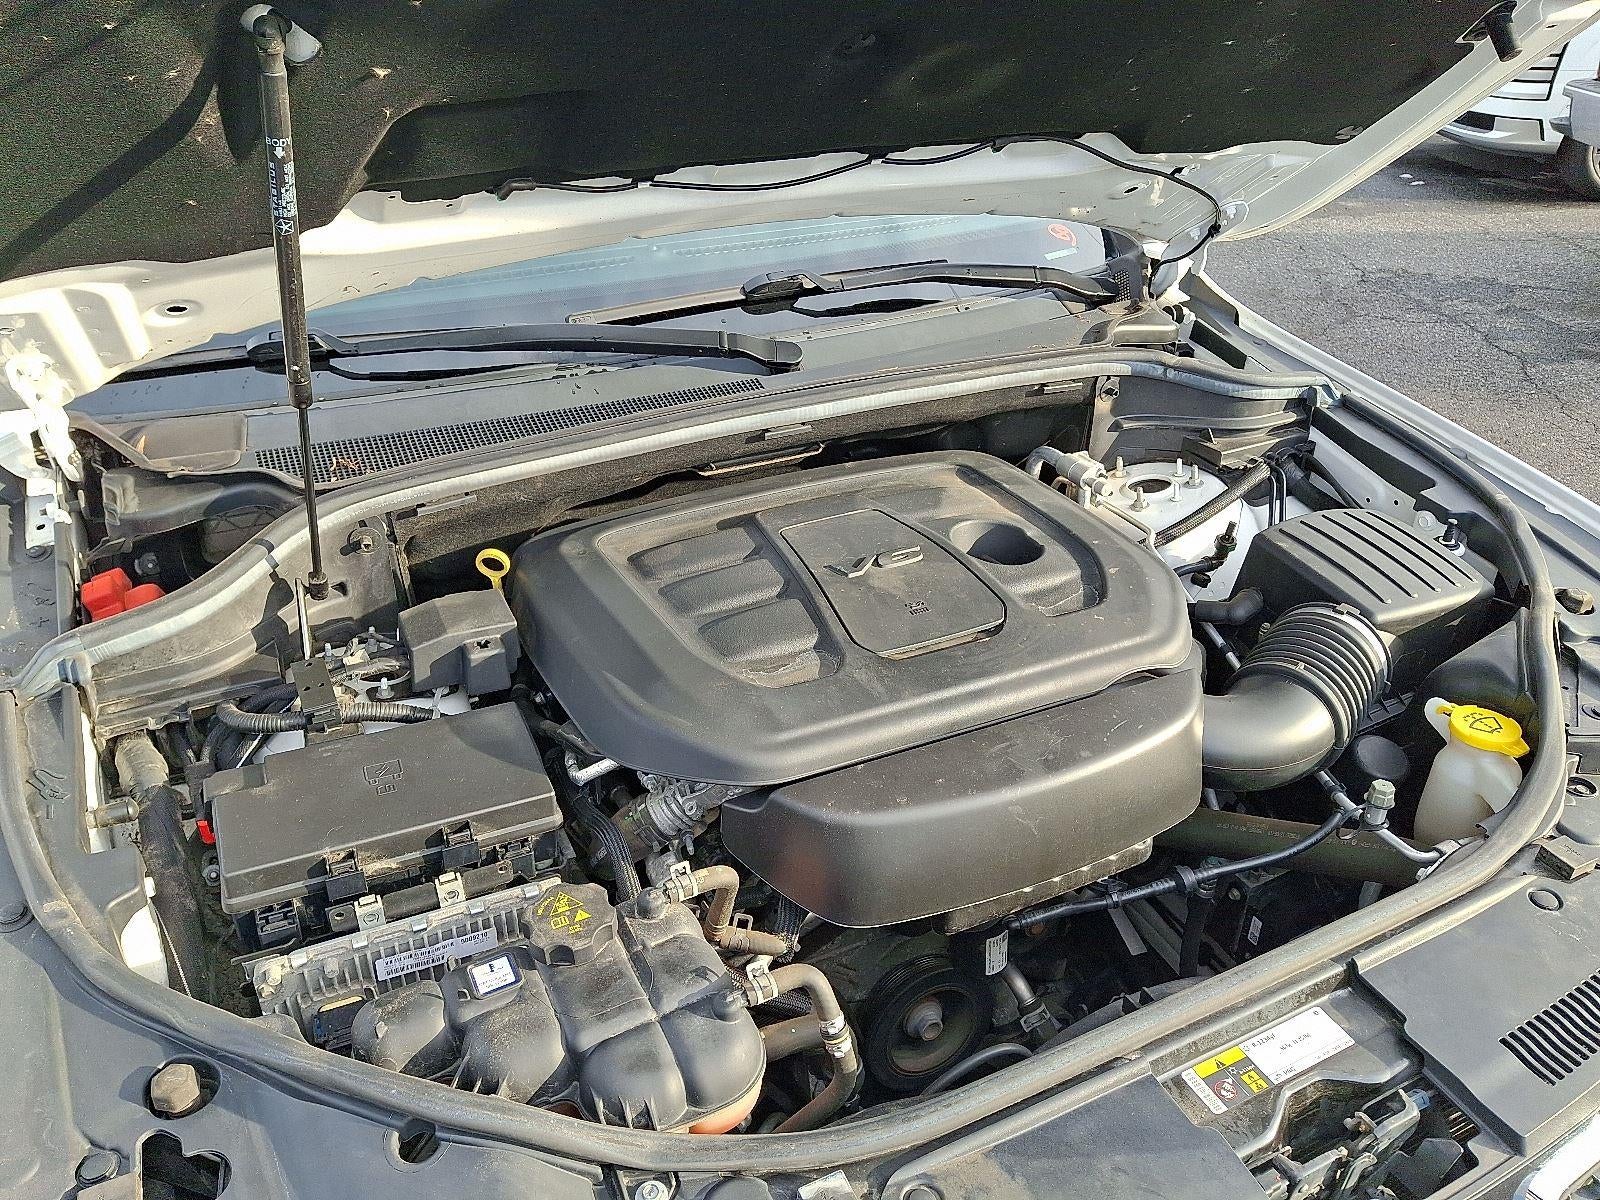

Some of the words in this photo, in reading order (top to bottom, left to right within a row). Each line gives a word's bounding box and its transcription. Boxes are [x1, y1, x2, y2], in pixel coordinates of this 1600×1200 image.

[266, 136, 291, 147] BODY
[269, 162, 280, 217] STABILUS
[823, 545, 924, 579] V6
